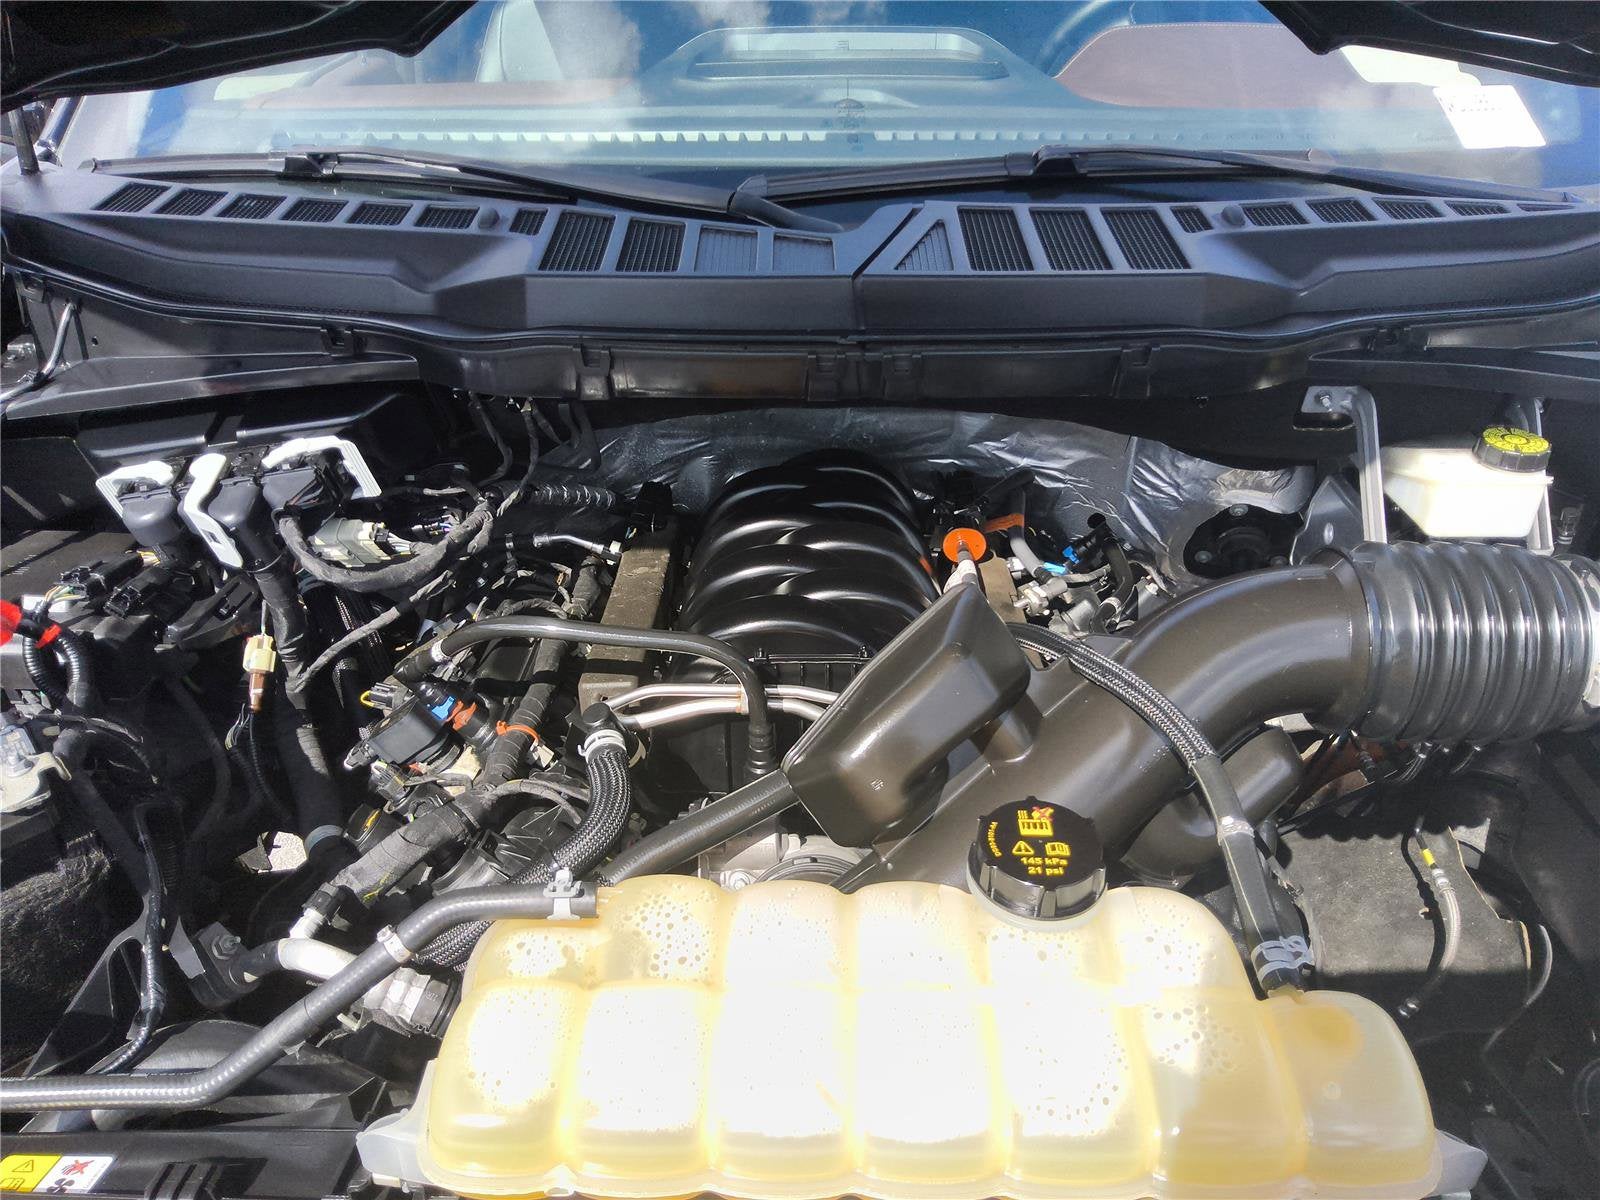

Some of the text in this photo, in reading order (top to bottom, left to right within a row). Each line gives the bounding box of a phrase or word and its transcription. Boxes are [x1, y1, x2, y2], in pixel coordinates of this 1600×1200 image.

[1020, 857, 1068, 866] 145 kPa
[1028, 866, 1065, 876] 21 psi
